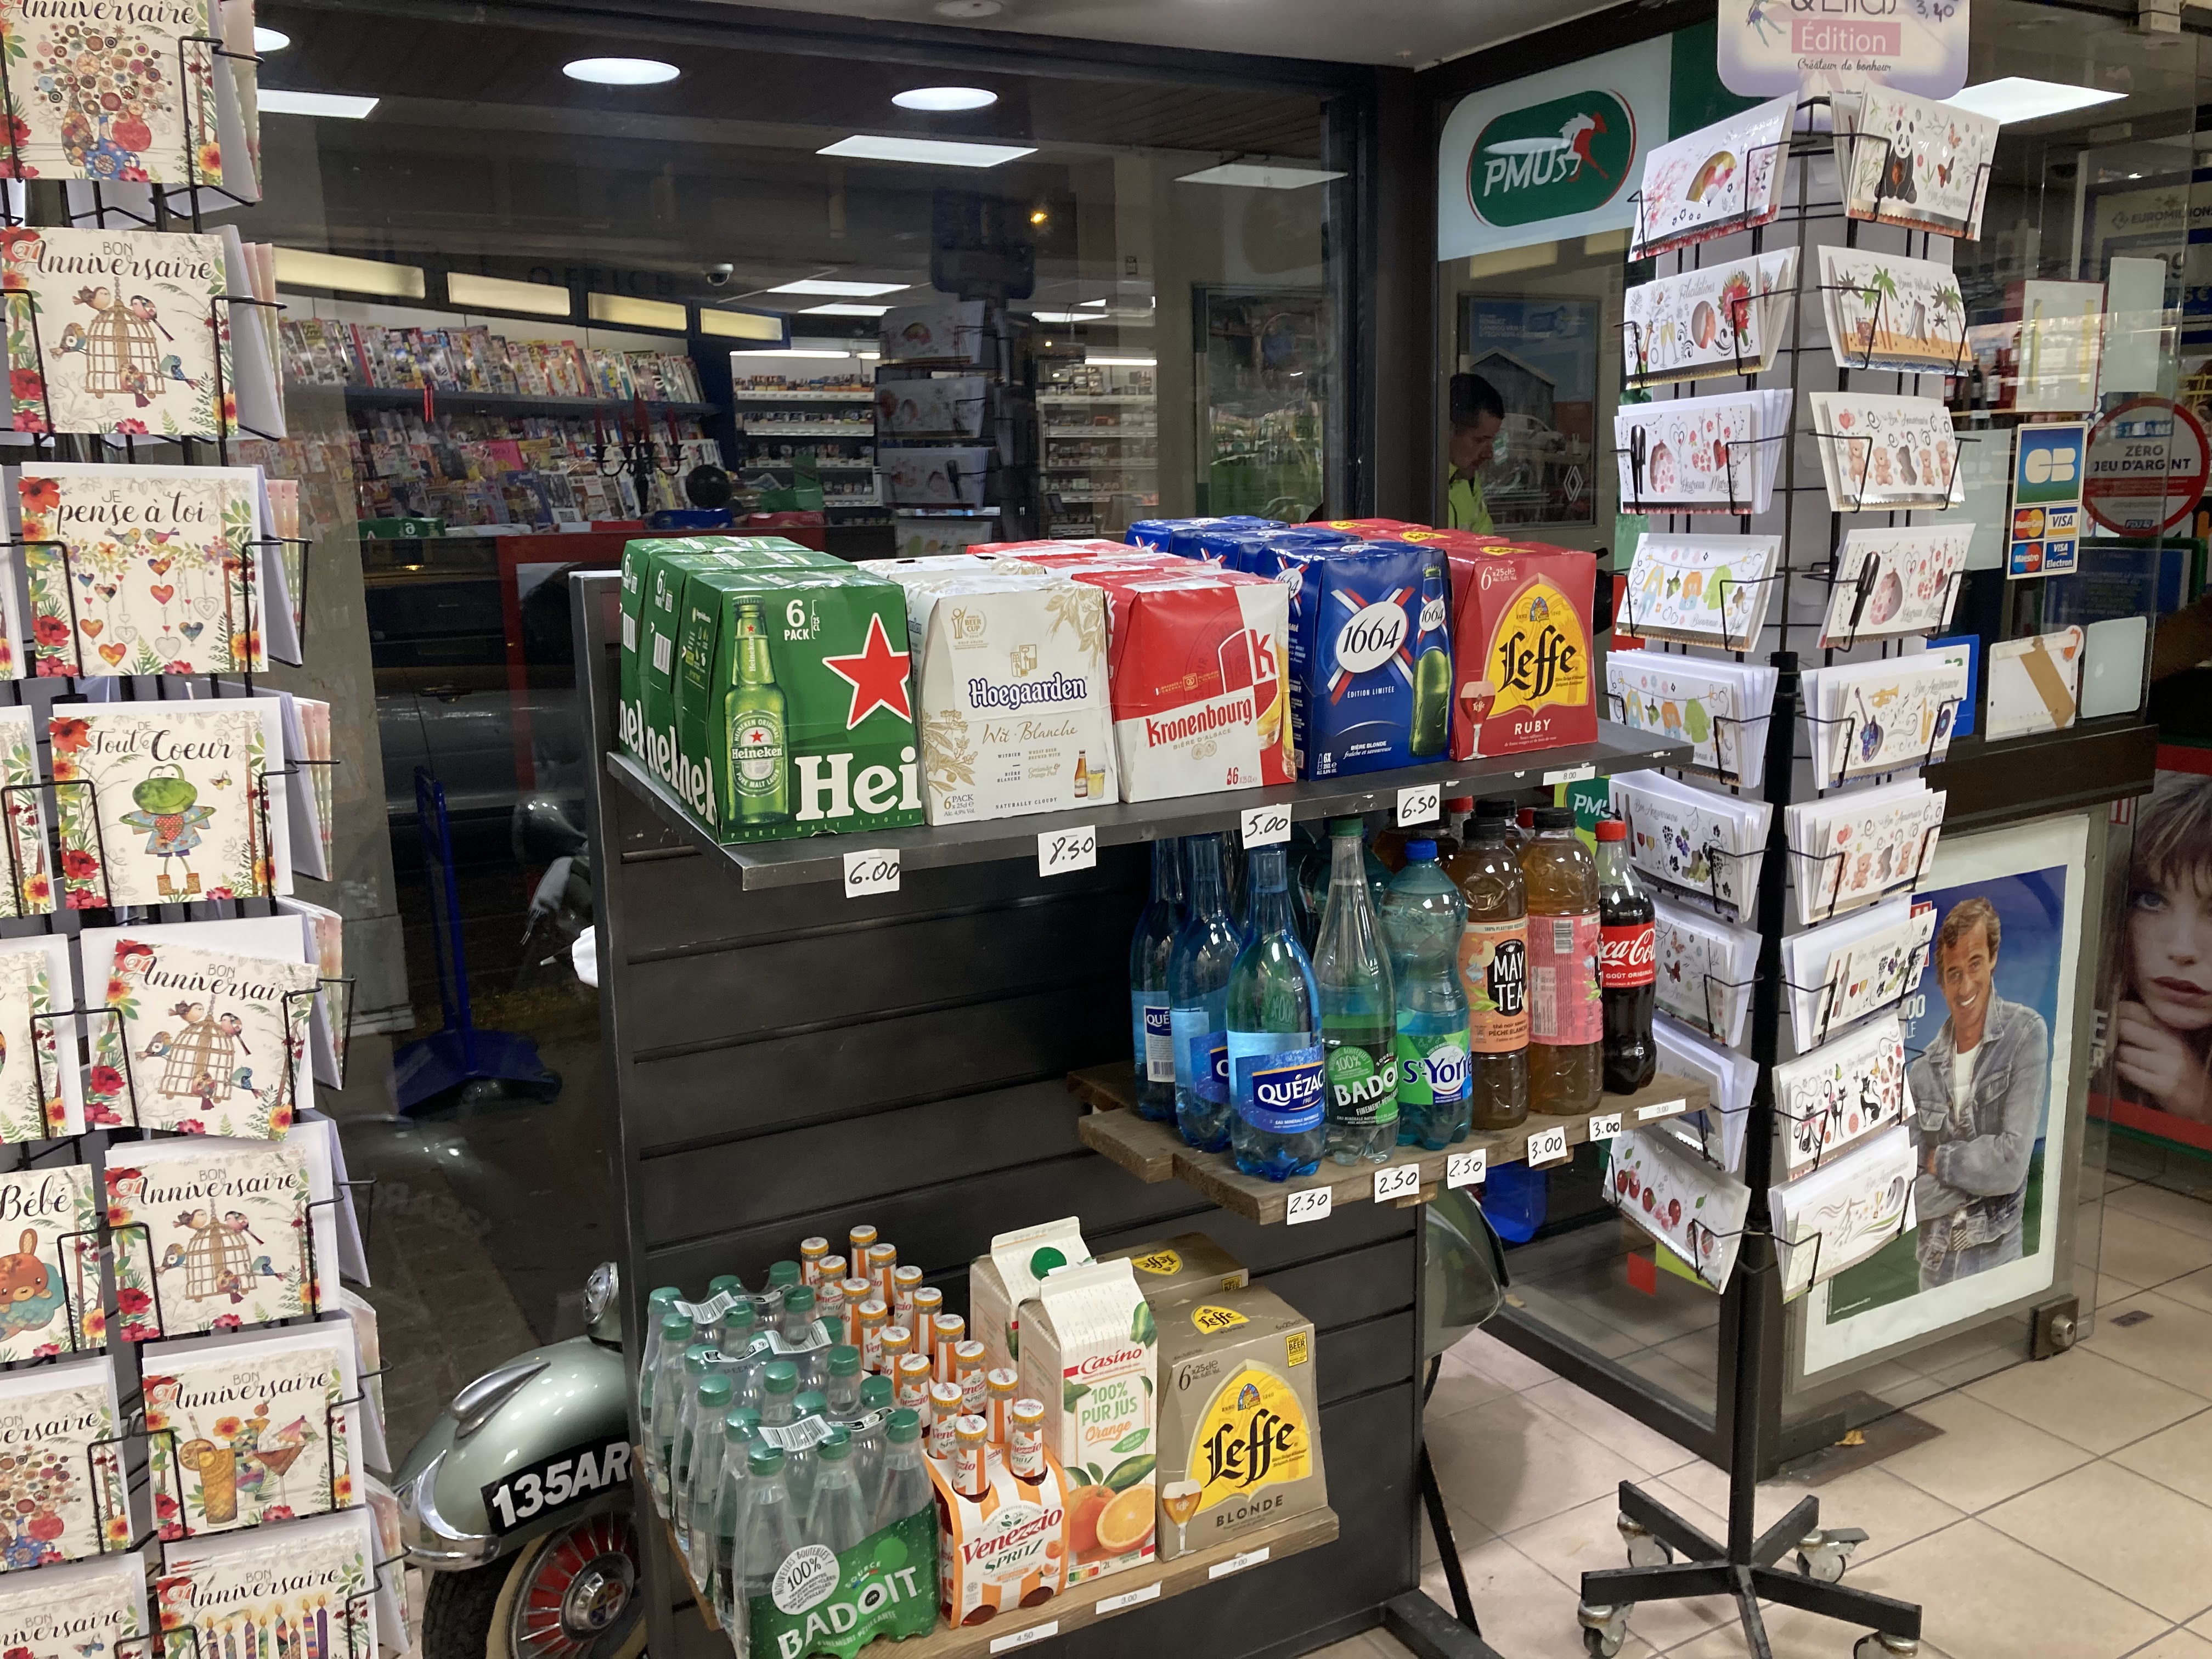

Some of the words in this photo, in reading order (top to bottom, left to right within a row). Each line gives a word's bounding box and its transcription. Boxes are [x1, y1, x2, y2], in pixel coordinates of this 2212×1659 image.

[1802, 21, 1886, 53] Édition
[1798, 58, 1837, 71] Créateur
[1842, 59, 1852, 71] de
[1857, 59, 1891, 71] bonheur
[1483, 146, 1558, 196] PMU
[103, 241, 132, 256] BON
[12, 239, 215, 280] Anniversaire
[2125, 444, 2163, 457] ZÉRO
[2025, 448, 2076, 483] CB
[2094, 461, 2118, 472] JEU
[2122, 459, 2191, 471] D'ARGNT
[102, 490, 122, 503] JE
[57, 500, 138, 535] pense
[145, 500, 165, 523] à
[163, 490, 208, 523] toi
[2052, 515, 2073, 527] VISA
[2053, 544, 2068, 552] VISA
[2047, 560, 2072, 568] Electron
[657, 569, 664, 594] 6
[1481, 566, 1492, 590] 6
[786, 600, 805, 627] 6
[1422, 606, 1443, 623] 1664
[784, 629, 810, 641] PACK
[1343, 617, 1400, 653] 1664
[1497, 624, 1577, 701] Leffe
[969, 671, 1087, 710] Hoegaarden
[1347, 688, 1370, 698] ÉDITION
[1373, 685, 1395, 696] LIMITÉE
[1473, 701, 1485, 713] Leffe
[138, 721, 151, 731] DE
[735, 720, 755, 741] HEINEKEN
[758, 719, 779, 738] ORIGINAL
[983, 723, 1010, 744] Wit
[1017, 720, 1077, 742] Blanche
[1146, 698, 1252, 748] Kronenbourg
[1515, 719, 1551, 735] RUBY
[88, 727, 140, 755] Tout
[140, 730, 234, 761] Coeur
[1173, 739, 1195, 750] BIÈRE
[1198, 729, 1231, 743] D'ALSACE
[1367, 741, 1386, 749] BLONDE
[732, 744, 782, 759] Heineken
[1324, 753, 1331, 763] 6X
[737, 772, 748, 788] PURE
[766, 769, 780, 785] LAGER
[1028, 765, 1053, 774] Coriander
[1232, 767, 1239, 785] 6
[795, 746, 922, 821] Hei
[944, 796, 951, 810] 6
[952, 794, 974, 802] PACK
[995, 800, 1031, 810] NATURALLY
[1401, 795, 1437, 819] 6.50
[731, 828, 776, 838] PURE
[797, 822, 840, 832] MALT
[860, 814, 913, 825] LAGER
[1244, 814, 1288, 839] 5.00
[849, 861, 900, 884] 6.00
[207, 964, 235, 978] BON
[1494, 951, 1524, 983] MAY
[1628, 969, 1652, 977] ORIGINAL
[123, 954, 305, 1005] Anniversaire
[1494, 981, 1524, 1011] TEA
[1488, 1028, 1509, 1036] PÊCHE
[1336, 1056, 1361, 1071] 100%
[1257, 1069, 1324, 1107] QUÉZAC
[1356, 1103, 1380, 1115] FINEMENT
[1656, 1105, 1669, 1114] 3.00
[1593, 1121, 1620, 1136] 3.00
[1531, 1136, 1562, 1156] 3.00
[200, 1168, 227, 1182] BON
[1448, 1159, 1482, 1177] 2.50
[117, 1171, 300, 1205] Anniversaire
[1379, 1172, 1418, 1195] 2.50
[1289, 1194, 1328, 1215] 2.50
[1198, 1312, 1235, 1328] Leffe
[1289, 1340, 1305, 1351] BEER
[1081, 1348, 1142, 1374] Casino
[233, 1372, 259, 1386] BON
[1179, 1364, 1191, 1391] 6
[153, 1369, 331, 1409] Anniversaire
[1091, 1380, 1128, 1404] 100%
[0, 1414, 24, 1427] ON
[1082, 1403, 1110, 1426] PUR
[1114, 1397, 1137, 1419] JUS
[1085, 1421, 1132, 1441] Orange
[1204, 1408, 1295, 1489] Leffe
[493, 1442, 630, 1527] 135AR
[1216, 1494, 1284, 1528] BLONDE
[962, 1509, 1062, 1565] Venezzio
[985, 1538, 1043, 1573] SPRITZ
[1232, 1556, 1248, 1567] 7.00
[246, 1569, 272, 1583] BON
[775, 1557, 795, 1596] NOUVELLES
[797, 1547, 831, 1561] BOUTEILLES
[787, 1557, 821, 1592] 100%
[845, 1561, 882, 1588] SOURCE
[166, 1567, 342, 1609] Anniversaire
[1121, 1593, 1137, 1604] 3.00
[25, 1613, 52, 1628] BON
[777, 1566, 917, 1659] BADOIT
[858, 1610, 897, 1637] PÉTILLANTE
[1017, 1631, 1033, 1641] 4.50
